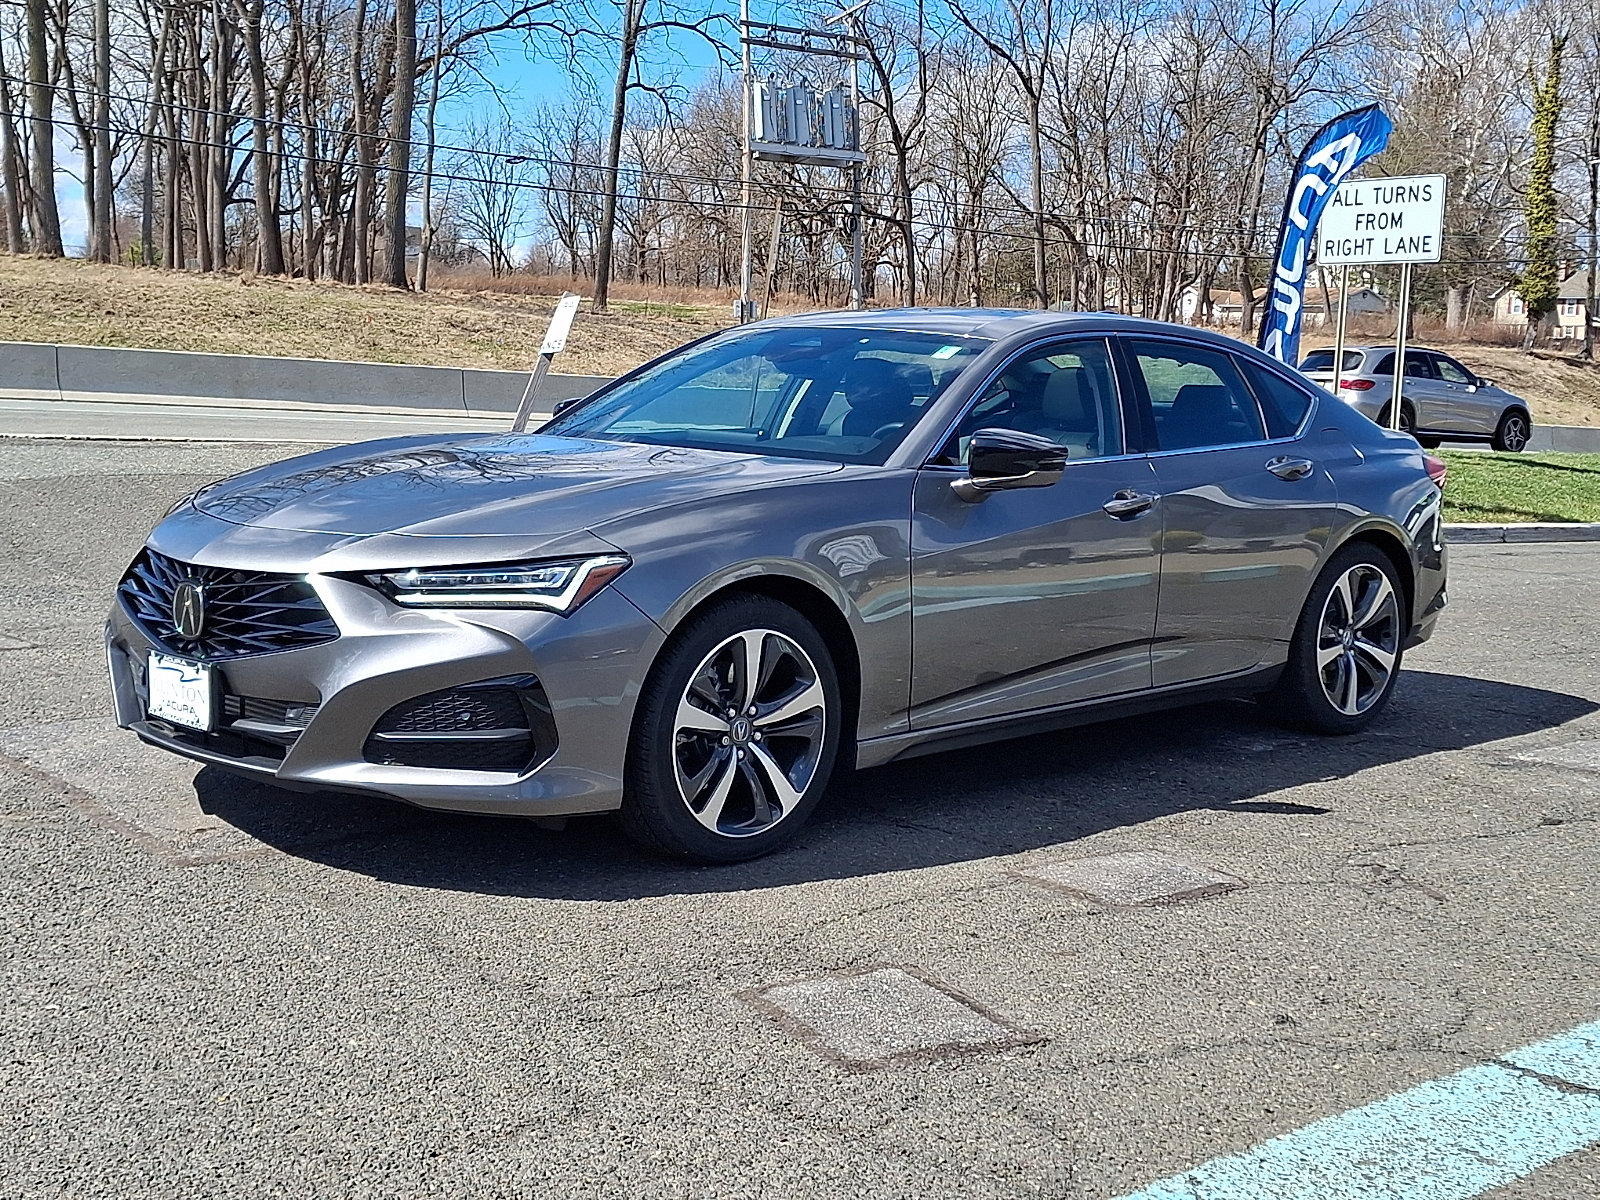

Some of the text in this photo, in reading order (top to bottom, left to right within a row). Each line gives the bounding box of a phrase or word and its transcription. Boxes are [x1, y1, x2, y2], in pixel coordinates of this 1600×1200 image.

[1332, 184, 1433, 207] ALL TURNS
[1355, 211, 1404, 231] FROM
[1324, 235, 1433, 257] RIGHT LANE
